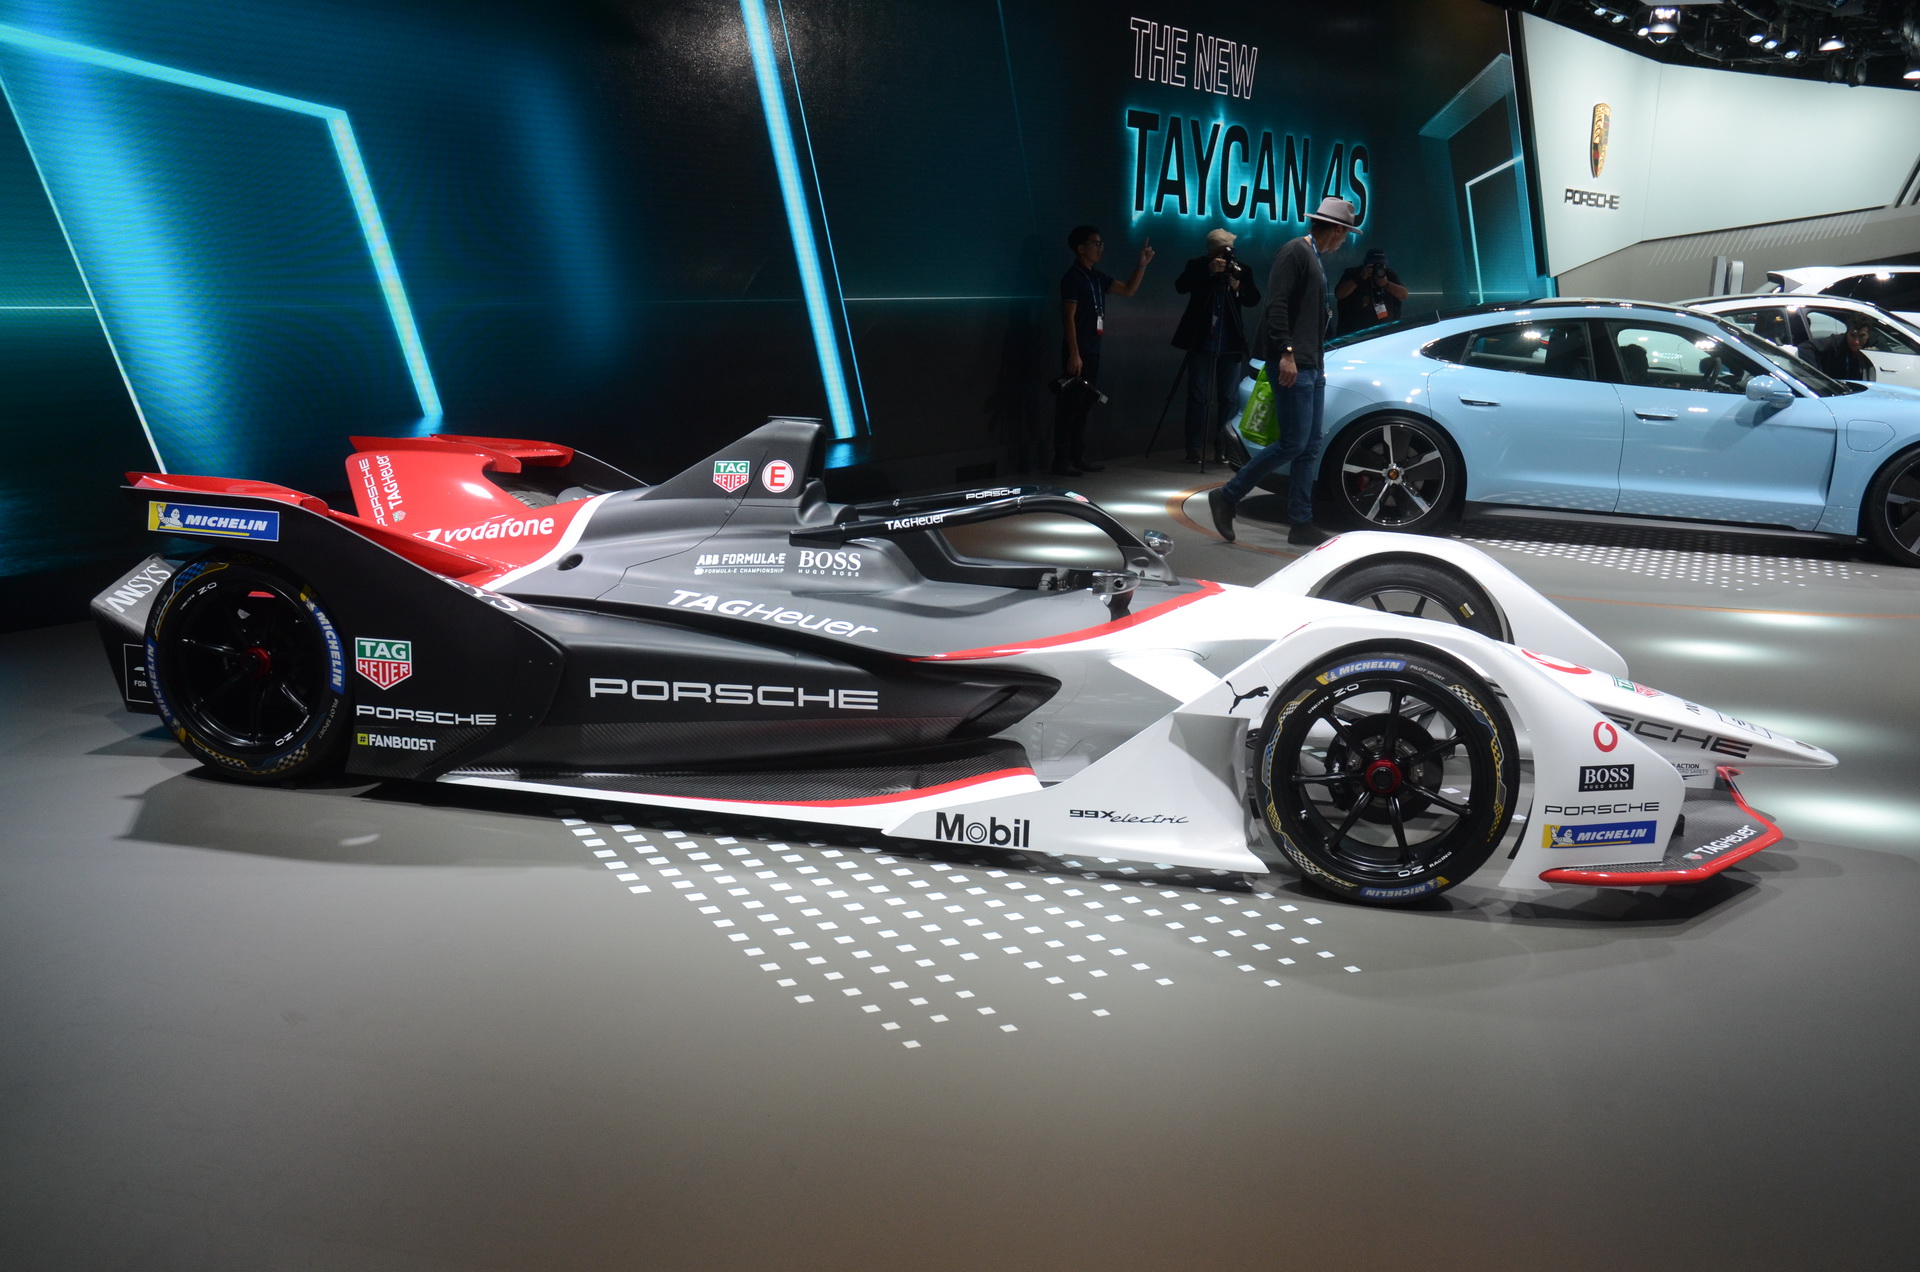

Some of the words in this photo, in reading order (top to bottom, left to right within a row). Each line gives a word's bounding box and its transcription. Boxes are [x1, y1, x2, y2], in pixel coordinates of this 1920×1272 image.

[1130, 17, 1188, 87] THE
[1194, 33, 1258, 99] NEW
[1126, 109, 1310, 224] TAYCAN
[1320, 142, 1369, 227] 4S
[1564, 188, 1620, 210] PORSCHE
[717, 463, 747, 473] TAG
[769, 466, 786, 486] E
[359, 458, 388, 526] PORSCHE
[715, 475, 747, 490] HEUER
[965, 488, 1021, 500] PORSCHE
[185, 514, 268, 532] MICHELIN
[444, 516, 555, 542] vodafone
[696, 554, 719, 565] ABB
[798, 550, 862, 571] BOSS
[316, 611, 342, 687] MICHELIN
[360, 641, 407, 660] TAG
[359, 660, 409, 687] HEUER
[1339, 661, 1401, 676] MICHELIN
[1410, 664, 1427, 673] PILOT
[1427, 670, 1446, 681] SPORT
[589, 677, 879, 711] PORSCHE
[356, 704, 497, 726] PORSCHE
[1601, 711, 1753, 759] SCHE
[1584, 767, 1630, 784] BOSS
[1544, 802, 1660, 816] PORSCHE
[935, 811, 1031, 848] Mobil
[1576, 828, 1648, 841] MICHELIN
[1429, 851, 1452, 868] RACING
[1365, 884, 1426, 896] MICHELIN
